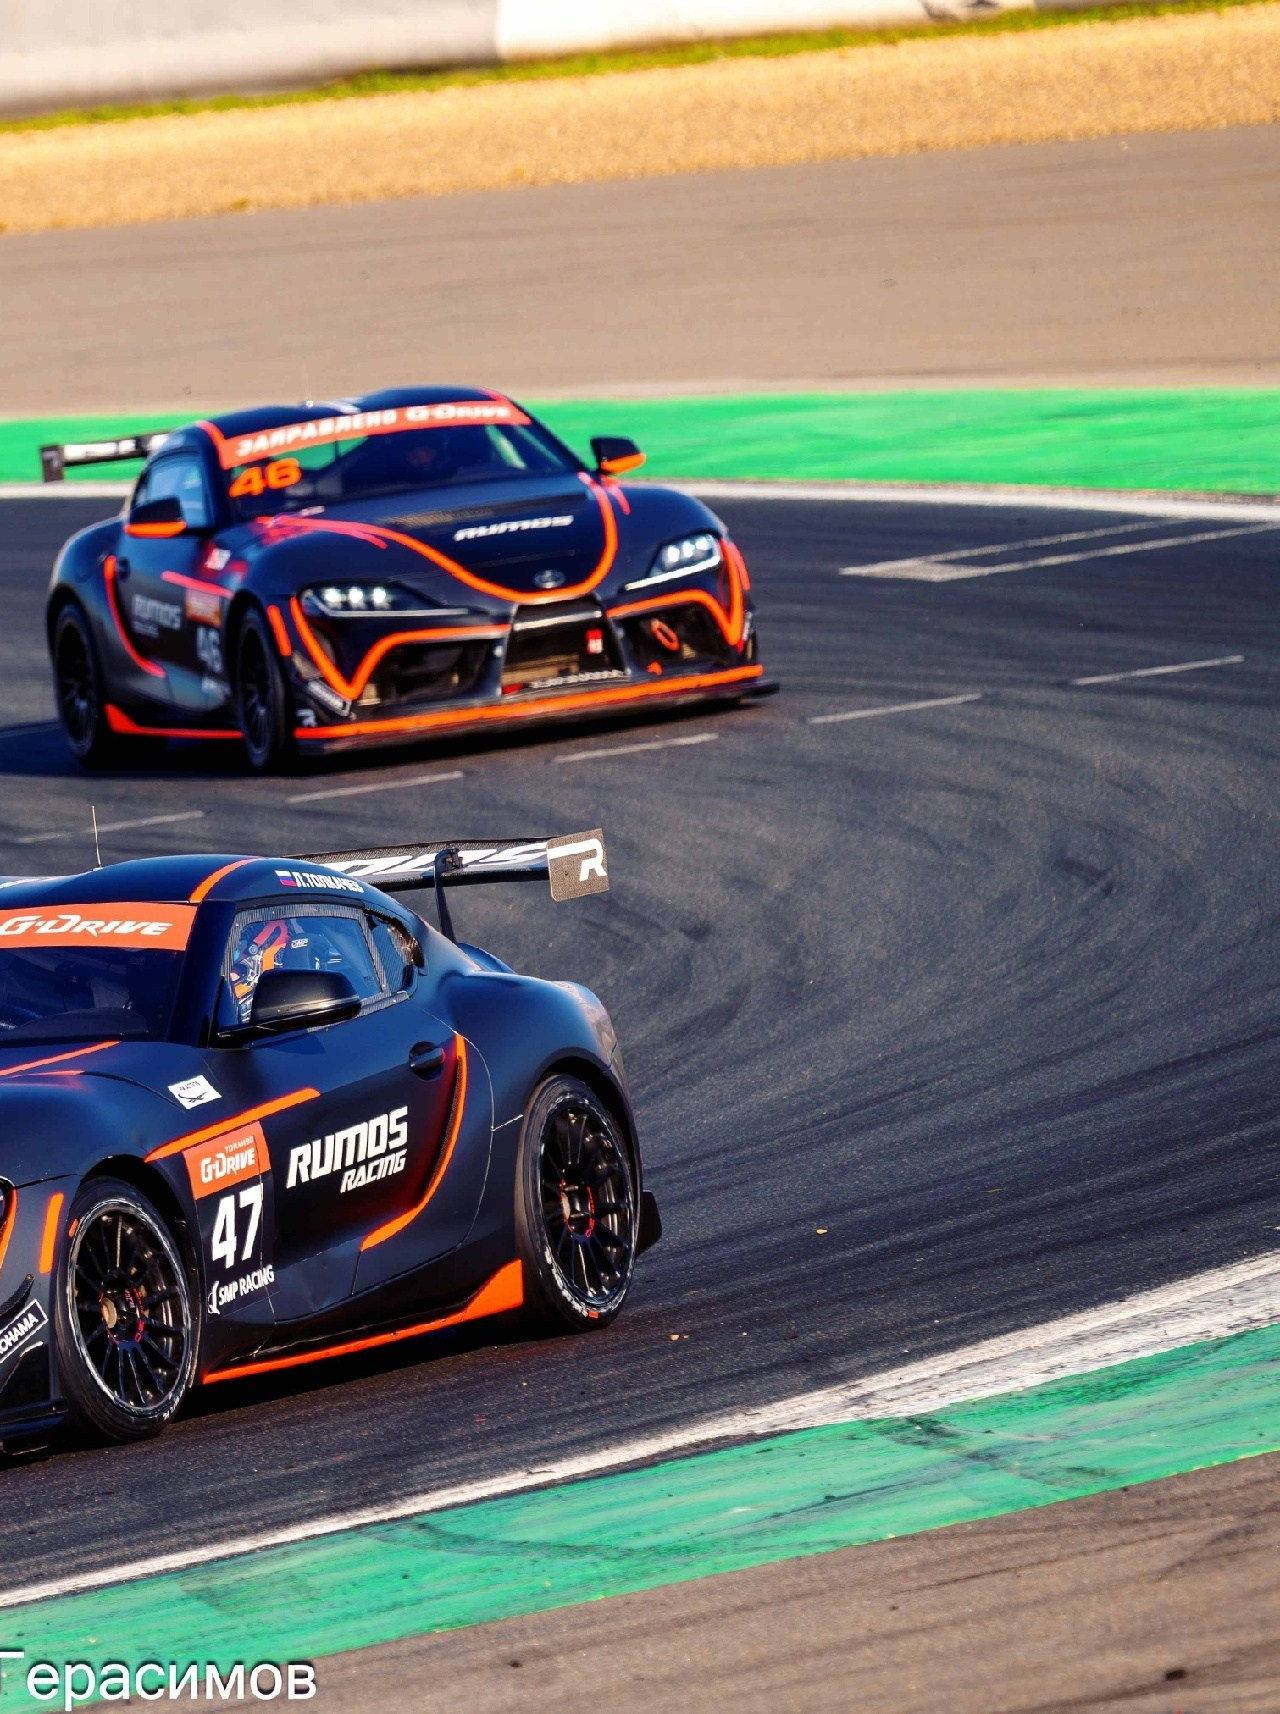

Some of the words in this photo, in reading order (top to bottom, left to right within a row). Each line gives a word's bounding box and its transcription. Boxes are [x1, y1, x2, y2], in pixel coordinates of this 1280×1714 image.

[229, 457, 302, 498] 46
[286, 1105, 408, 1190] RUMOS
[340, 1148, 408, 1194] RACING
[212, 1182, 264, 1270] 47
[218, 1280, 239, 1306] SMP
[239, 1263, 275, 1297] RACING
